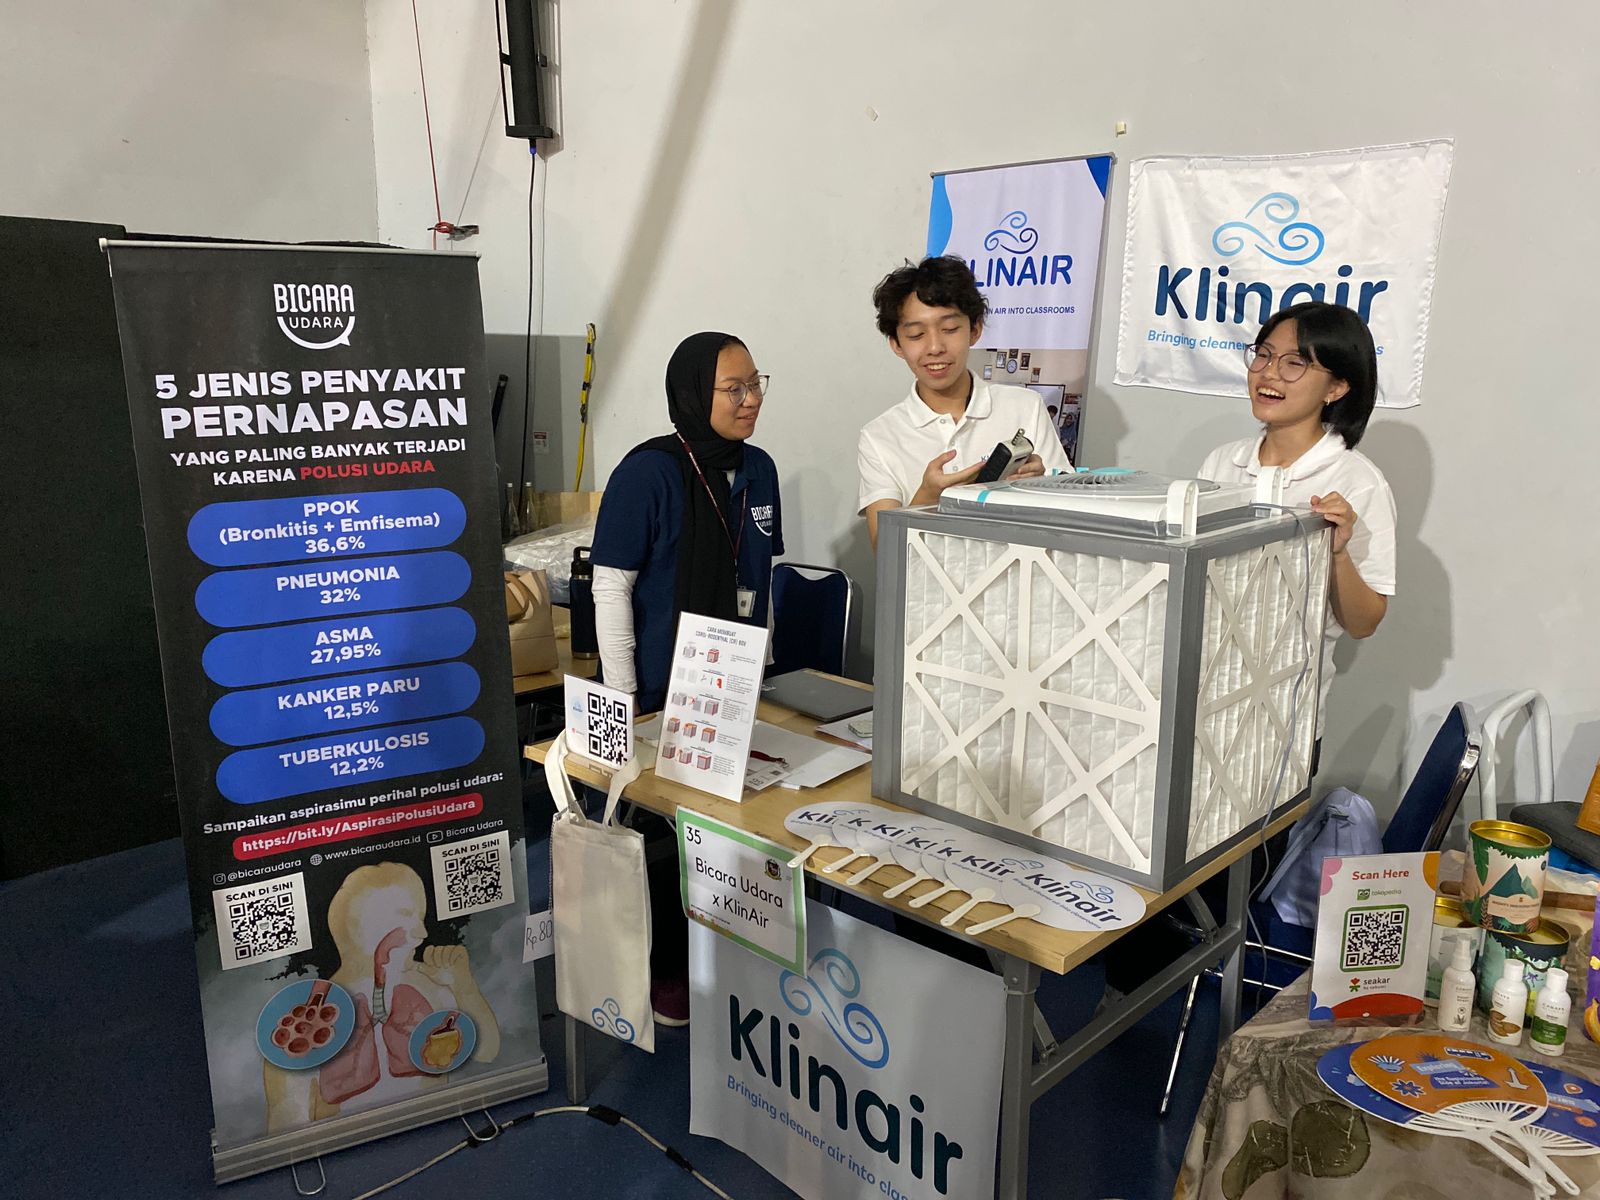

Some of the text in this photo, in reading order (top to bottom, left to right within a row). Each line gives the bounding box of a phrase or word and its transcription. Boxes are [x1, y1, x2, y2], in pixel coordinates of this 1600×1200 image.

[970, 255, 1073, 287] LINAIR
[273, 283, 355, 313] BICARA
[1025, 306, 1075, 314] CLASSROOMS
[289, 316, 344, 329] UDARA
[1147, 330, 1197, 350] Bringing
[155, 367, 466, 400] 5 JENIS PENYAKIT
[160, 398, 468, 440] PERNAPASAN
[170, 438, 466, 467] YANG PALING BANYAK TERJADI
[213, 460, 436, 486] KARENA POLUSI UDARA
[303, 500, 360, 518] PPOK
[219, 521, 318, 546] (Bronkitis
[340, 512, 441, 533] Emfisema)
[305, 536, 366, 555] 36,6%
[276, 565, 401, 592] PNEUMONIA
[320, 587, 361, 605] 32%
[315, 626, 374, 647] ASMA
[310, 643, 382, 665] 27,95%
[278, 677, 421, 711] KANKER PARU
[323, 700, 380, 721] 12,5%
[279, 731, 430, 769] TUBERKULOSIS
[330, 756, 385, 777] 12,2%
[203, 772, 504, 835] Sampaikan aspirasimu perihal polusi udara:
[242, 798, 477, 853] https://bit.ly/AspirasiPolusiUdara
[686, 826, 702, 845] 35
[227, 818, 504, 882] @bicaraudara www.bicaraudara.id Bicara Udara
[441, 839, 501, 858] SCAN DI SINI
[695, 856, 784, 908] Bicara Udara
[1352, 869, 1410, 881] Scan Here
[225, 881, 294, 902] SCAN DI SINI
[1025, 873, 1122, 923] Klinair
[712, 894, 720, 907] x
[723, 896, 769, 928] KlinAir
[1363, 977, 1391, 986] seakar
[729, 994, 964, 1195] Klinair
[727, 1074, 778, 1120] Bringing
[779, 1111, 826, 1150] cleaner
[827, 1142, 847, 1165] air
[848, 1154, 876, 1185] into
